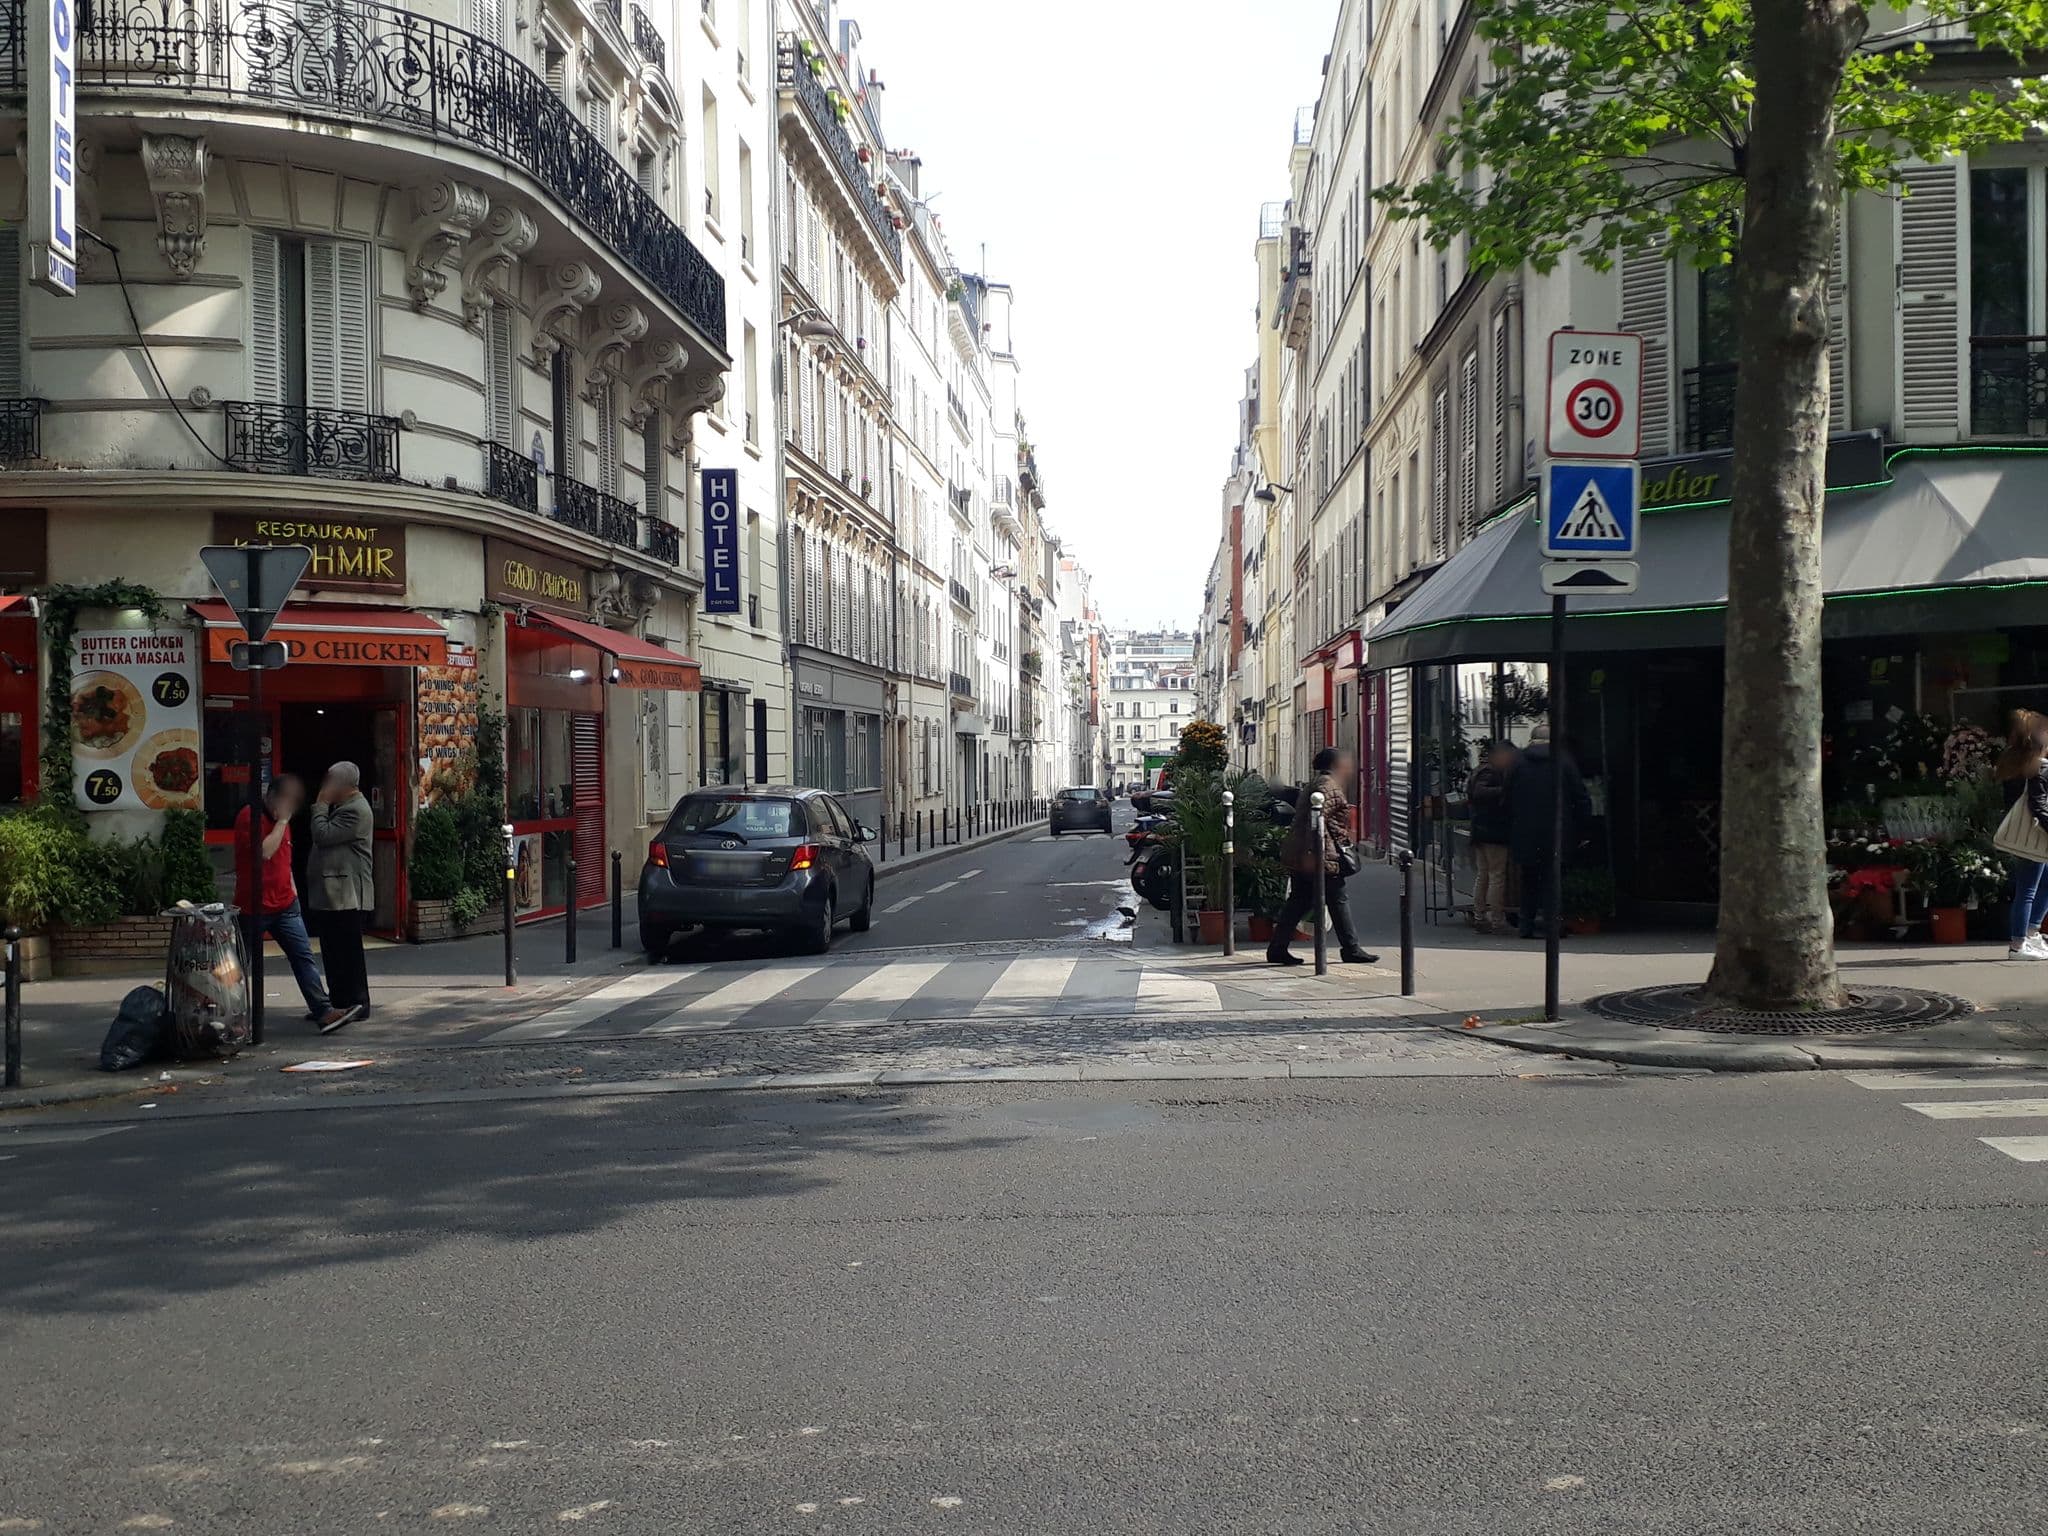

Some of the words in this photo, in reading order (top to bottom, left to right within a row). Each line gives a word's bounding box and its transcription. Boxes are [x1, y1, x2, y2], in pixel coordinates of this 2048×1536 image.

[53, 0, 72, 250] OTEL
[1570, 349, 1622, 366] ZONE
[1577, 396, 1612, 421] 30
[1640, 465, 1719, 503] telier
[257, 521, 378, 542] RESTAURANT
[710, 478, 730, 592] HOTEL
[234, 537, 395, 578] HMIR
[503, 559, 537, 591] GOOD
[540, 567, 580, 603] CHICKEN
[81, 637, 126, 650] BUTTER
[131, 635, 184, 650] CHICKEN
[313, 640, 431, 662] CHICKEN
[81, 653, 93, 666] ET
[98, 652, 132, 665] TIKKA
[136, 651, 185, 665] MASALA
[424, 680, 432, 690] 10
[434, 680, 455, 691] WINGS
[424, 702, 432, 712] 20
[434, 702, 457, 714] WINGS
